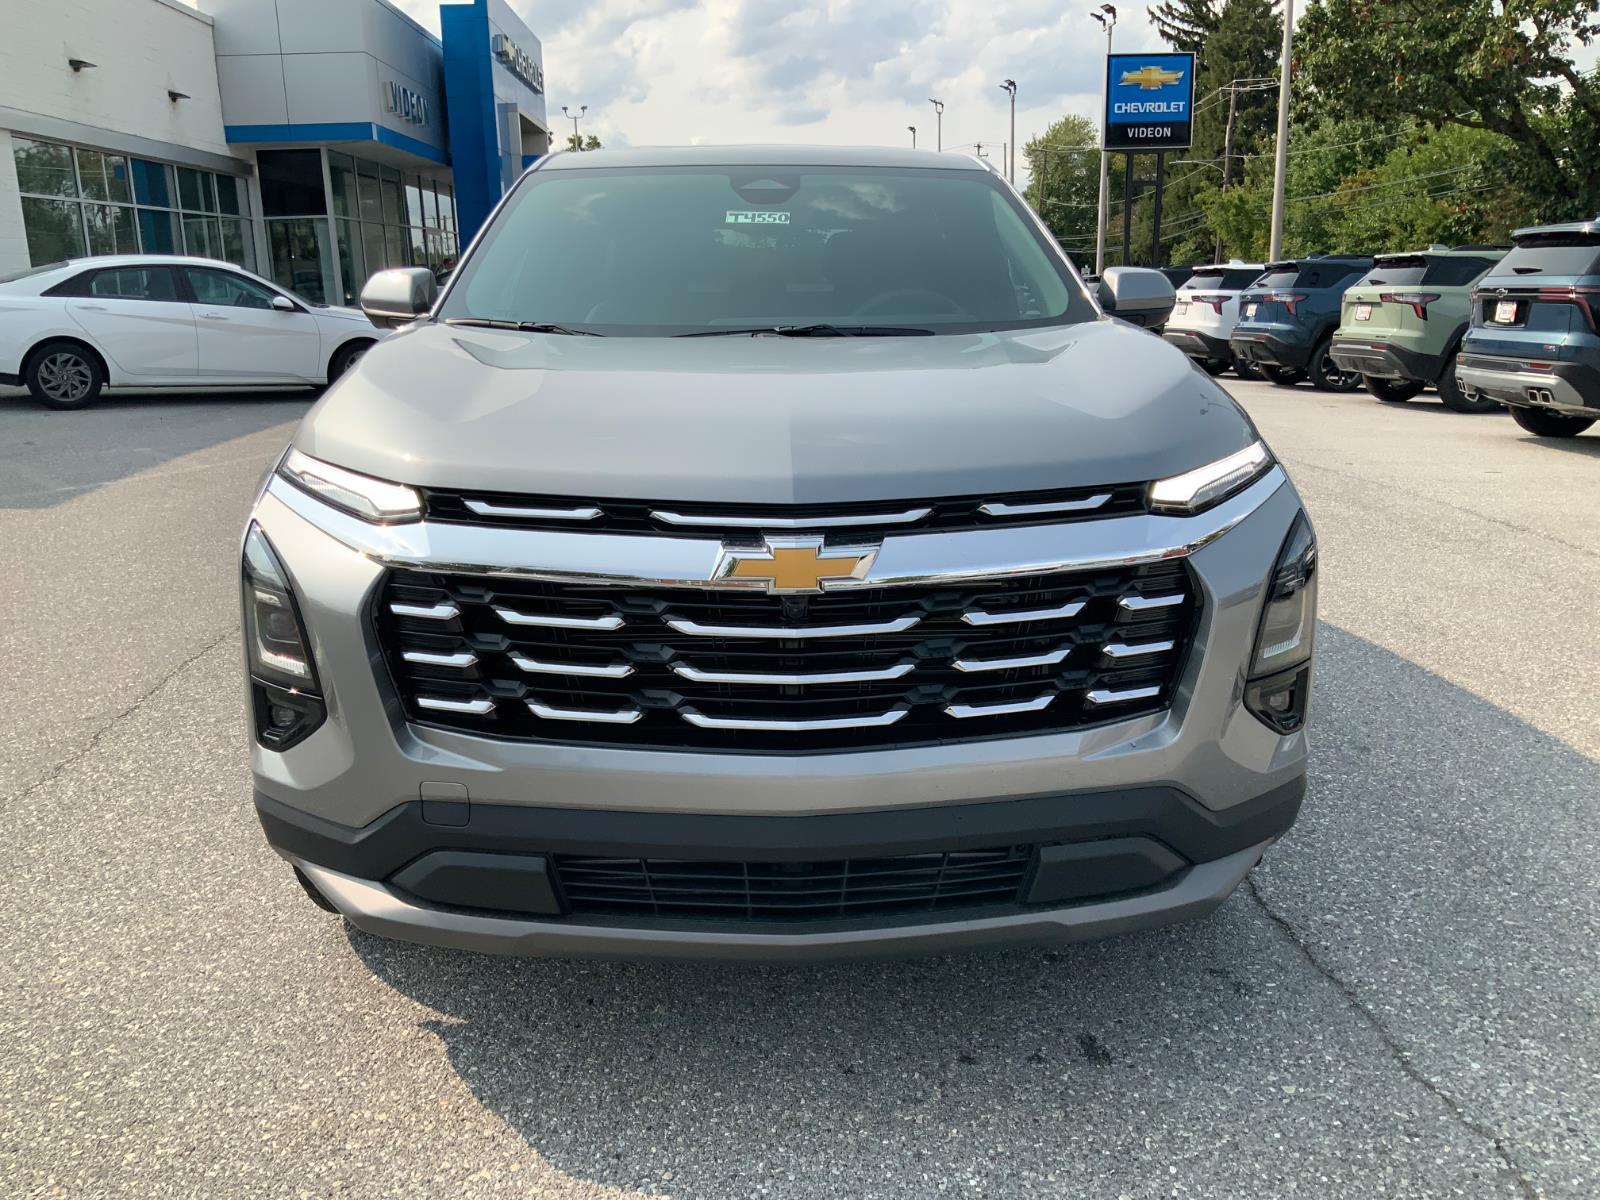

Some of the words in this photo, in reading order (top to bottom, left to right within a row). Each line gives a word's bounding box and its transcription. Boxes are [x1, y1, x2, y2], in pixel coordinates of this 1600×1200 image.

[384, 80, 430, 127] VIDEON
[1114, 101, 1185, 114] CHEVROLET
[1127, 127, 1171, 138] VIDEON
[728, 212, 790, 224] T4550
